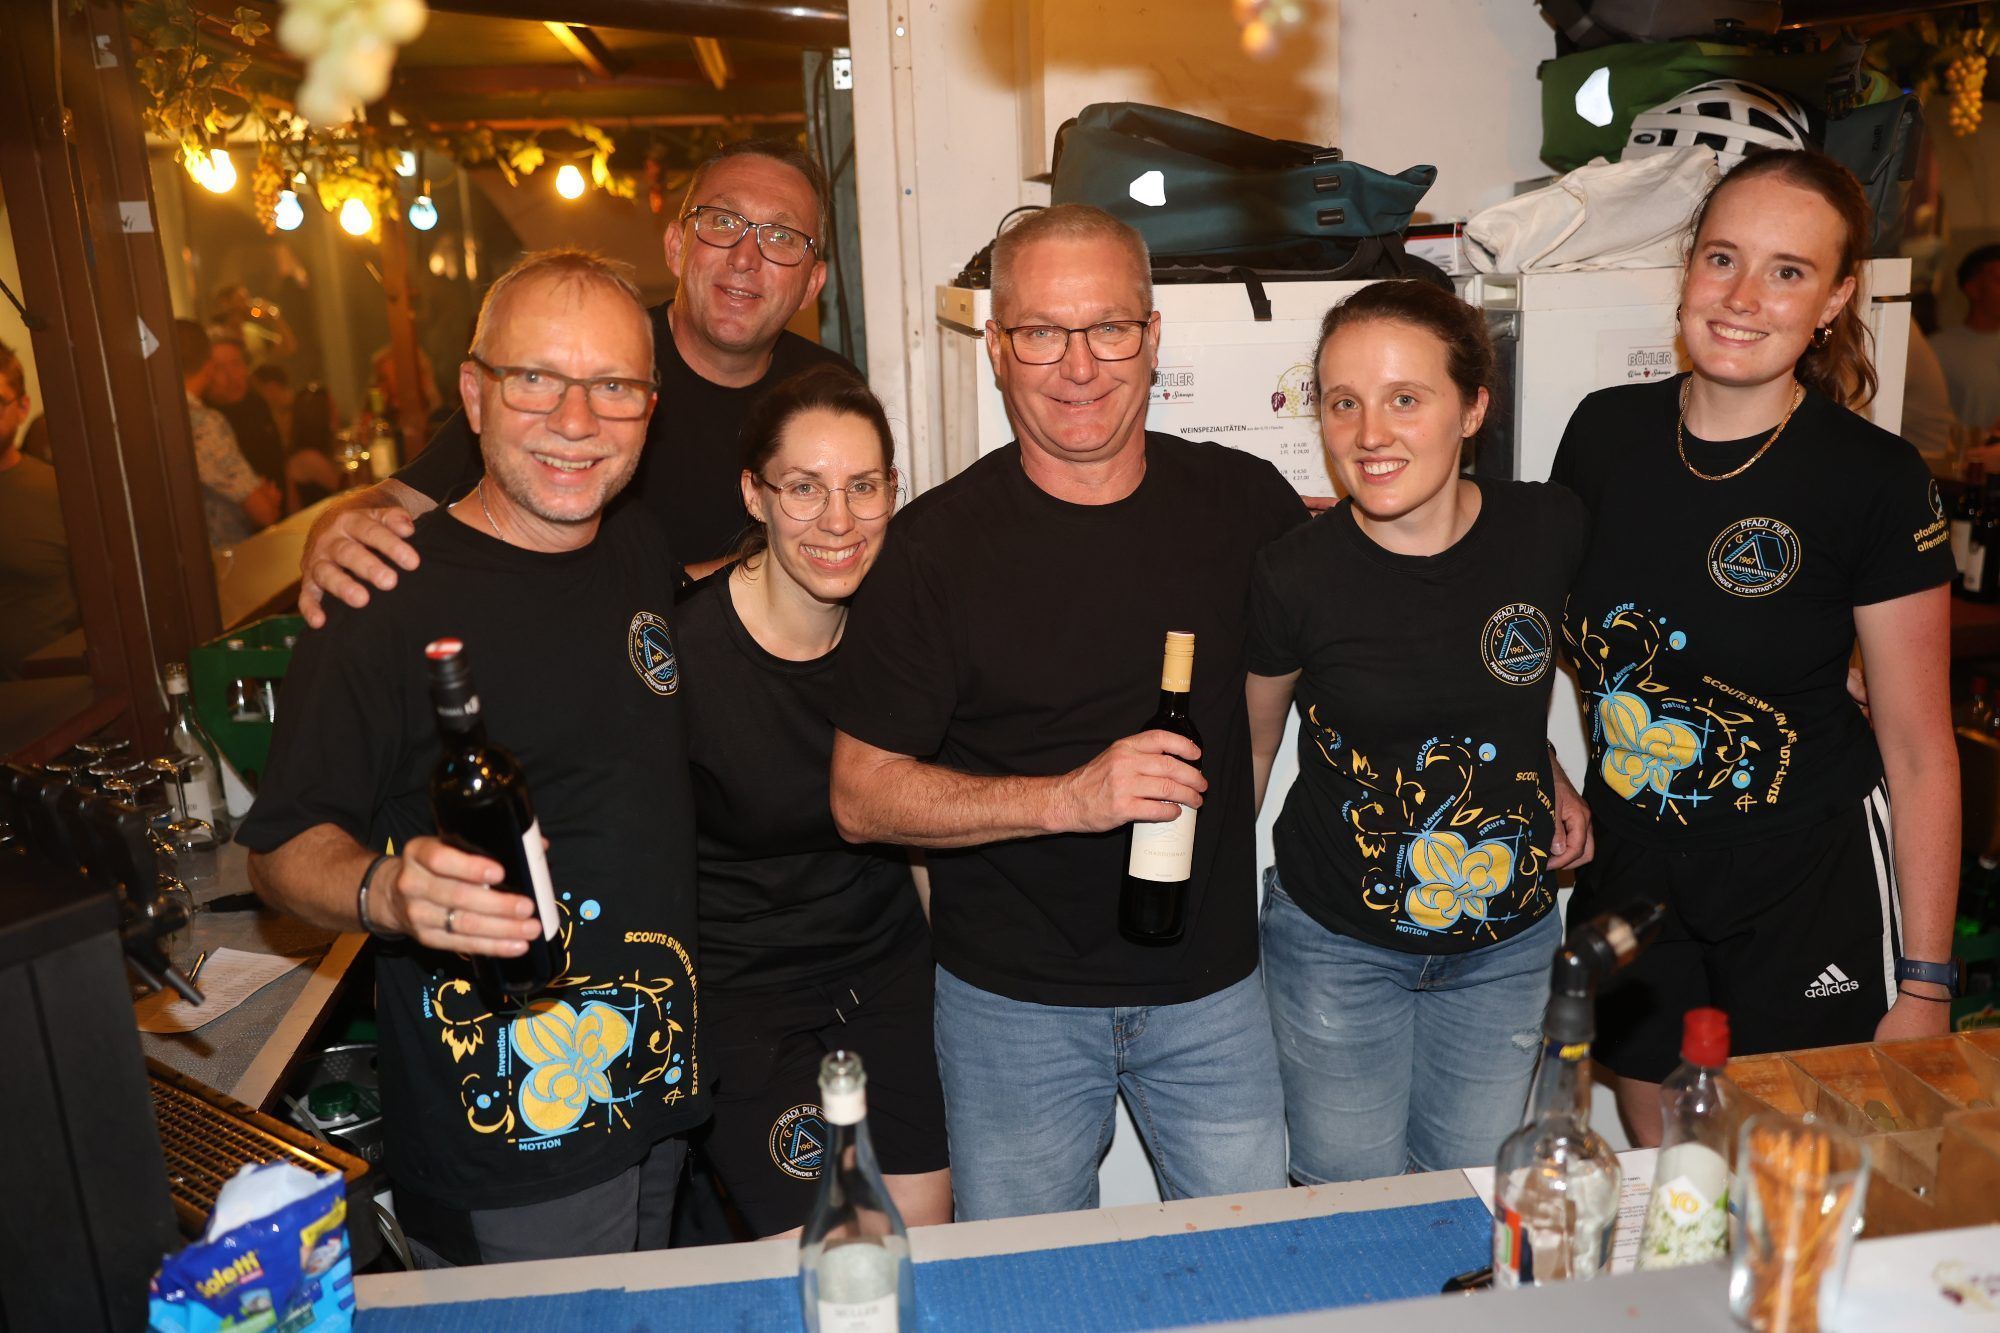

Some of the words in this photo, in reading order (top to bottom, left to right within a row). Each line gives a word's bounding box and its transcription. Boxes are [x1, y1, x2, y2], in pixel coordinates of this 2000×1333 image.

[1627, 350, 1672, 366] BÖHLER
[1153, 371, 1194, 387] ÖHLER
[1180, 424, 1247, 434] WEINSPEZIALITÄTEN
[1740, 518, 1769, 530] PFADI
[1771, 522, 1790, 537] PUR
[1739, 556, 1756, 565] 1967
[1492, 607, 1516, 624] PFADI
[1518, 605, 1535, 616] PUR
[1602, 602, 1635, 629] EXPLORE
[1509, 645, 1525, 655] 1967
[1702, 675, 1747, 701] SCOUTS
[1661, 701, 1691, 712] nature
[1415, 736, 1440, 772] EXPLORE
[1423, 794, 1456, 829] Adventure
[1478, 818, 1506, 837] nature
[624, 931, 668, 945] SCOUTS
[1395, 924, 1429, 937] MOTION
[1804, 979, 1860, 999] adidas
[497, 1027, 506, 1077] Invention
[778, 1108, 800, 1127] PFADI
[802, 1106, 817, 1115] PUR
[518, 1138, 562, 1151] MOTION
[799, 1141, 813, 1152] 1967
[781, 1162, 814, 1178] PFADFINDER
[1668, 1189, 1699, 1213] YO
